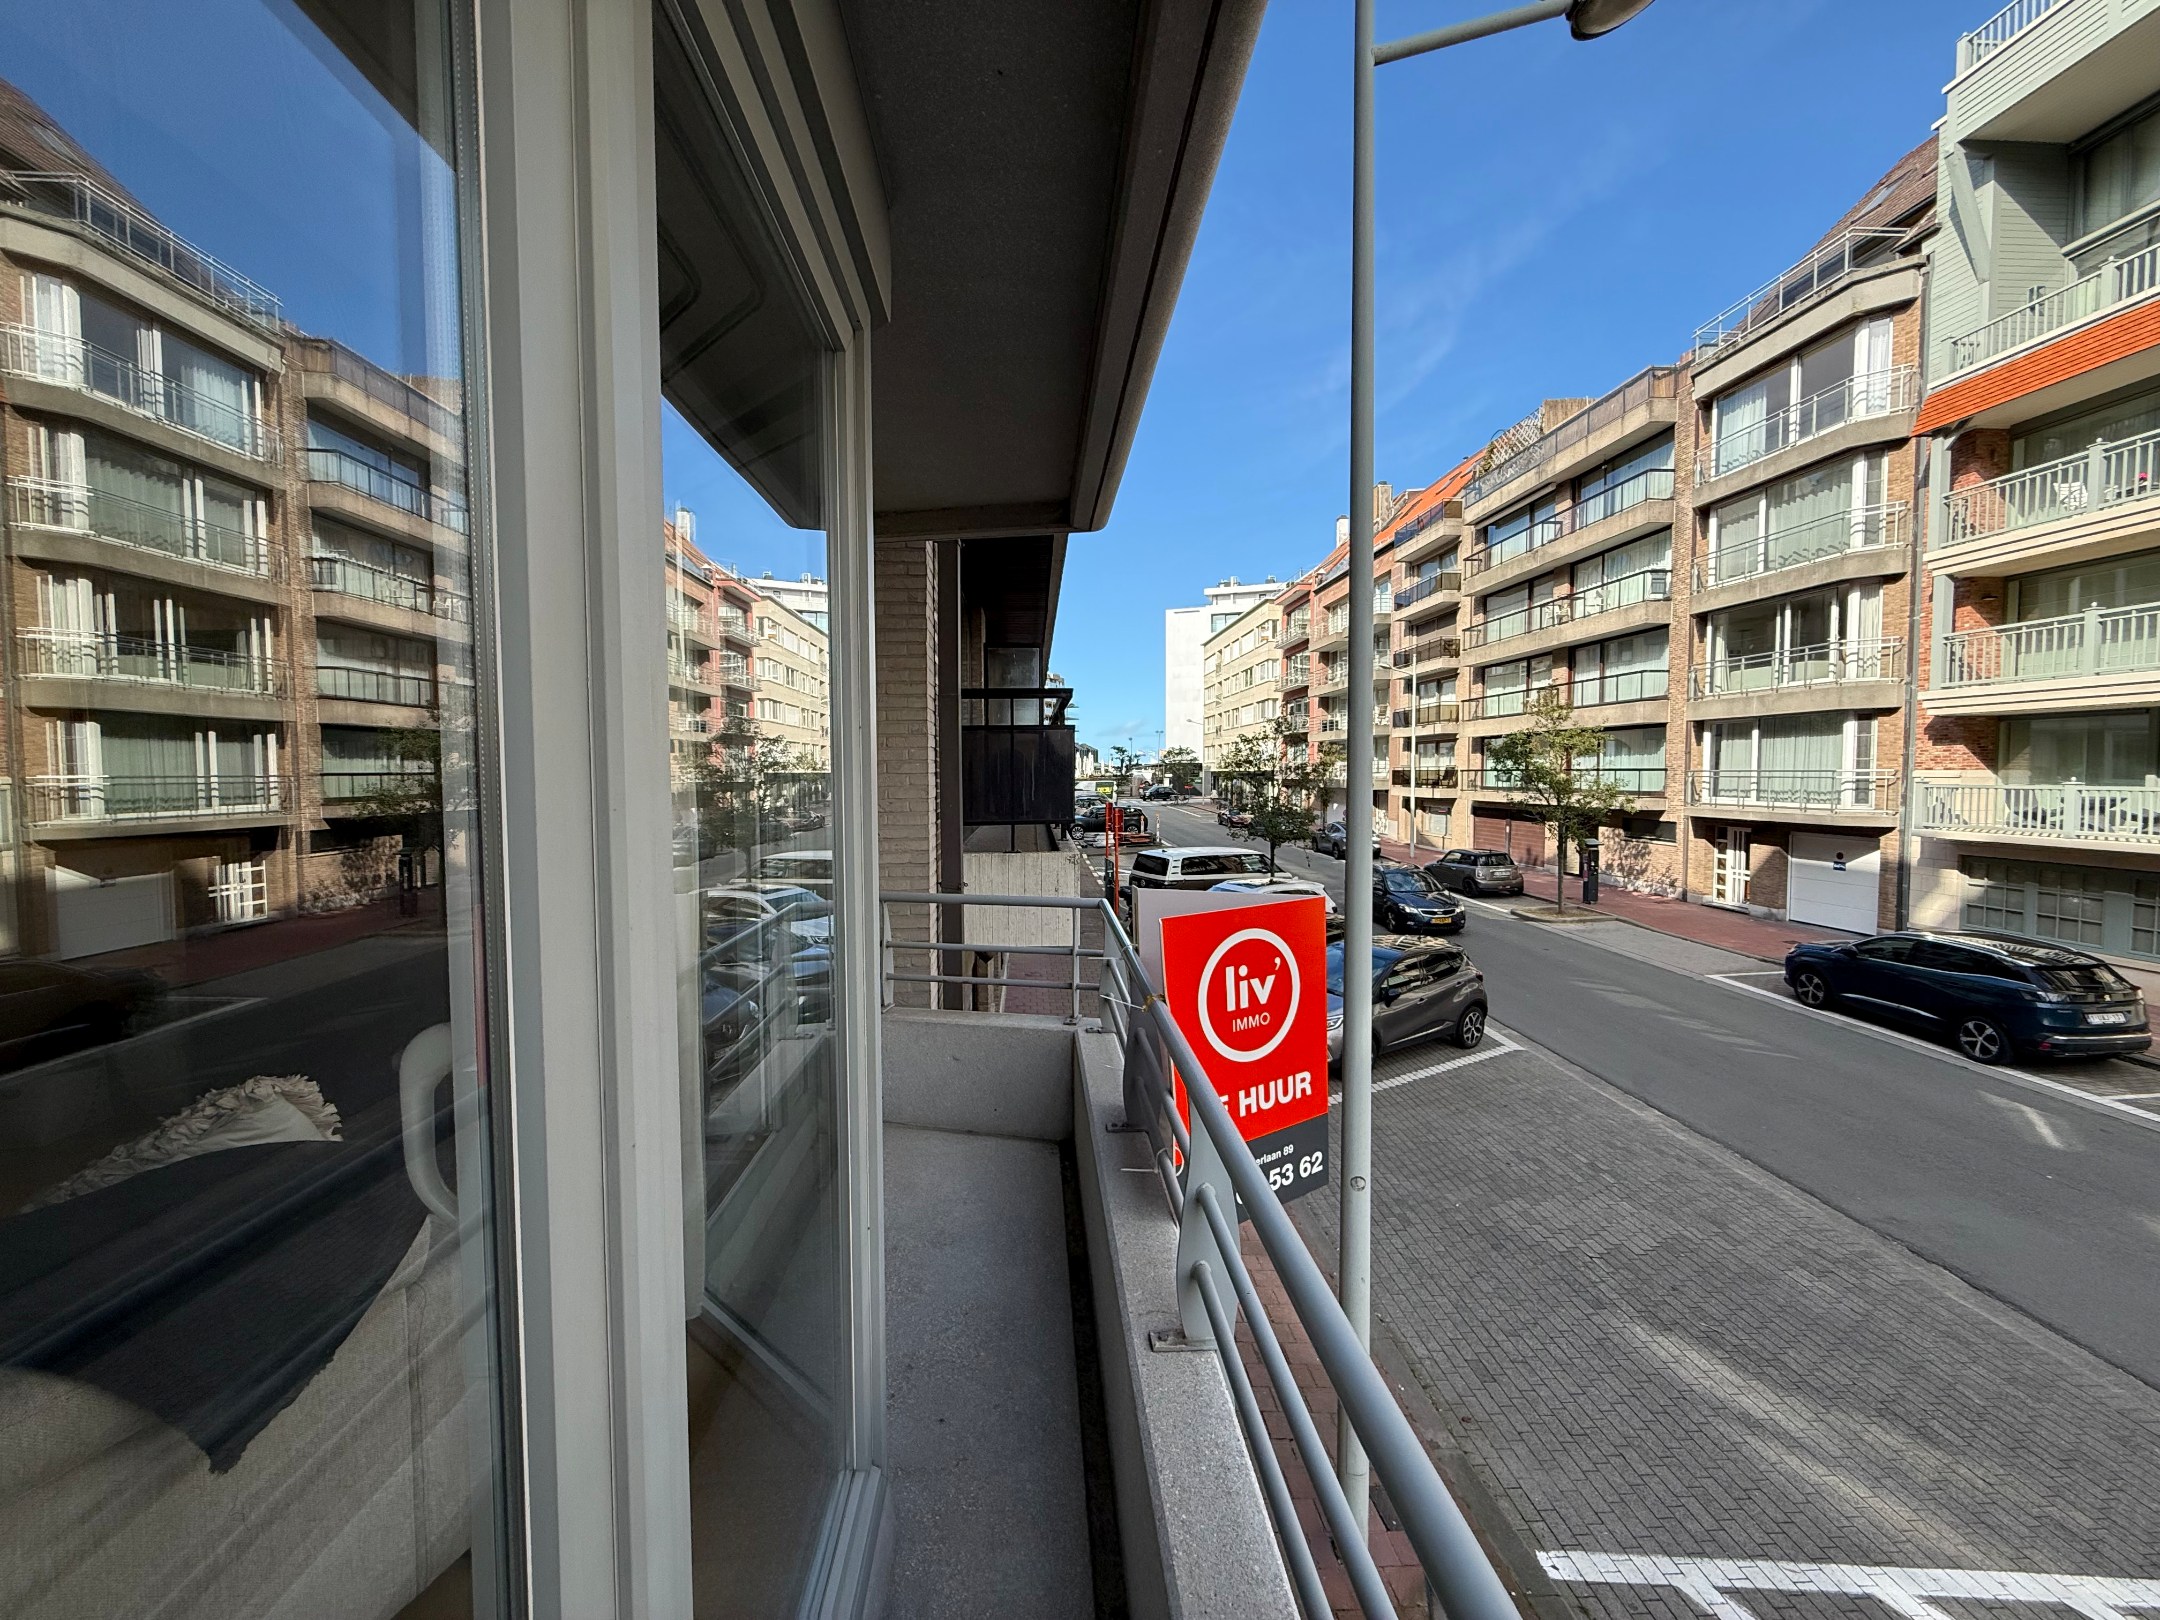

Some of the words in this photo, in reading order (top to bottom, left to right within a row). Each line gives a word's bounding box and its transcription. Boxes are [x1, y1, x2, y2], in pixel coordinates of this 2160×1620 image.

[1232, 1012, 1271, 1033] IMMO
[1238, 1071, 1312, 1118] HUUR
[1255, 1150, 1282, 1166] erlaan
[1283, 1144, 1294, 1156] 89
[1269, 1163, 1294, 1191] 53
[1299, 1151, 1324, 1178] 62
